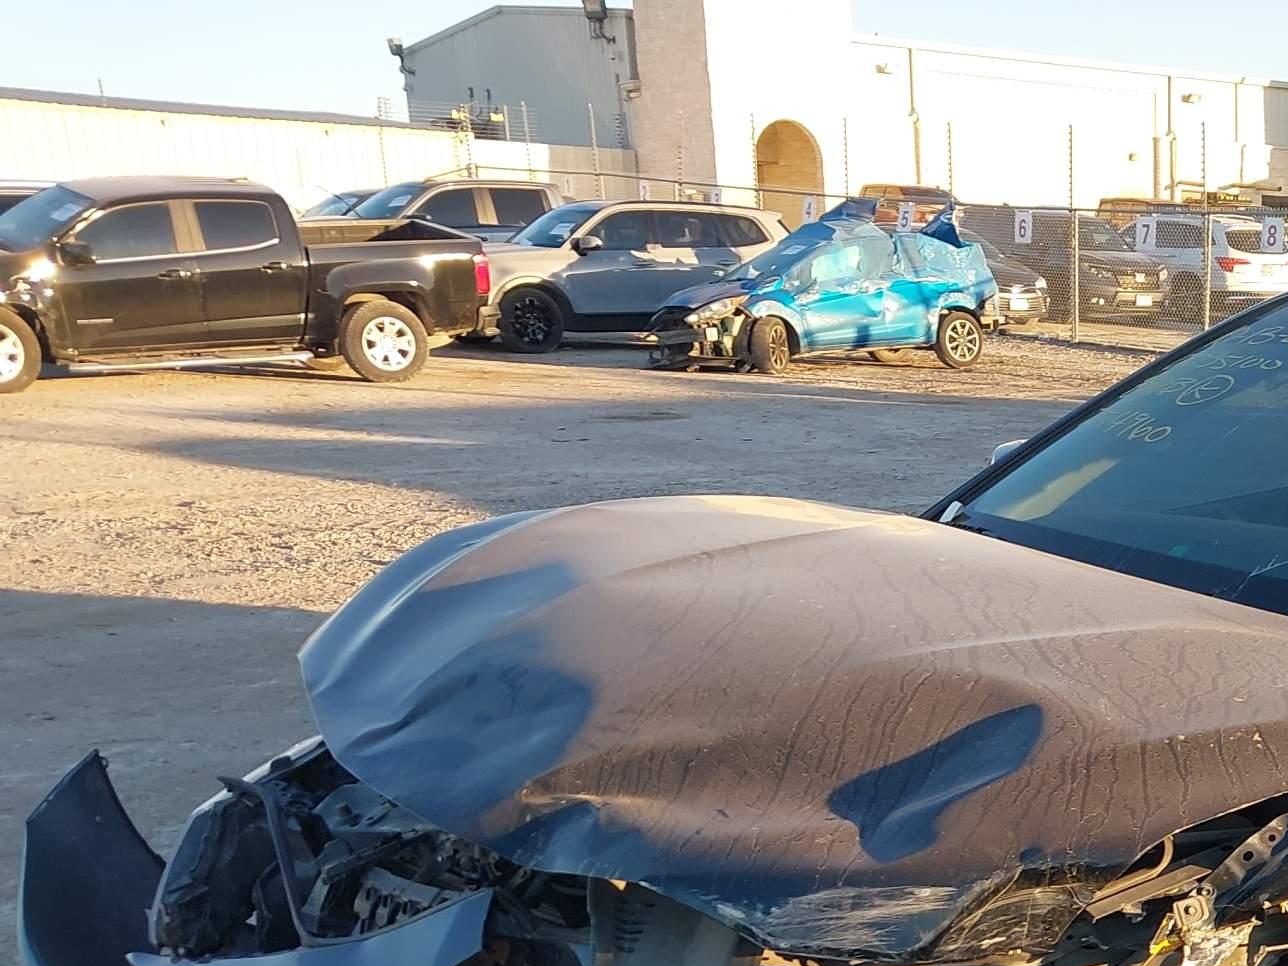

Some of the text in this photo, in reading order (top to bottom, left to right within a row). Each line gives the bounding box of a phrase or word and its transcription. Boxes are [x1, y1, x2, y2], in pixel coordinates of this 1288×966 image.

[901, 211, 909, 228] 5
[1018, 219, 1027, 238] 6
[1141, 224, 1151, 244] 7
[1267, 225, 1277, 246] 8
